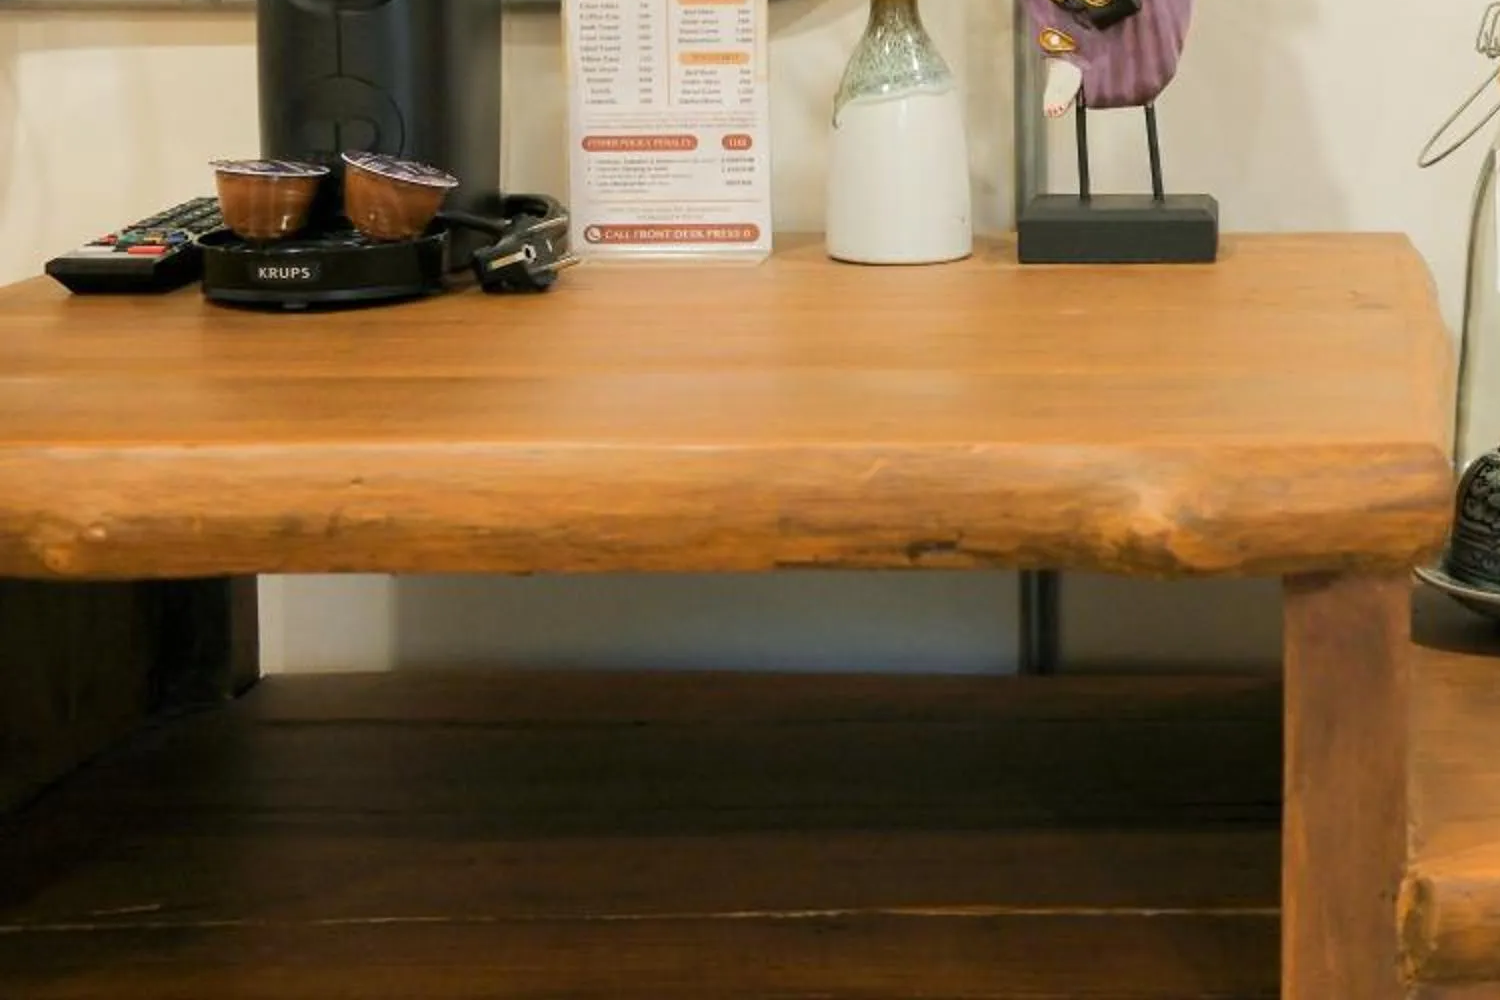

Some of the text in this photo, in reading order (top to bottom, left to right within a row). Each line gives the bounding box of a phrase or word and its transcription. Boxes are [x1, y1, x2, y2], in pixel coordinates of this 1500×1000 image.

[605, 229, 630, 240] CALL
[633, 229, 670, 240] FRONT
[674, 229, 703, 240] DESK
[258, 267, 311, 279] KRUPS
